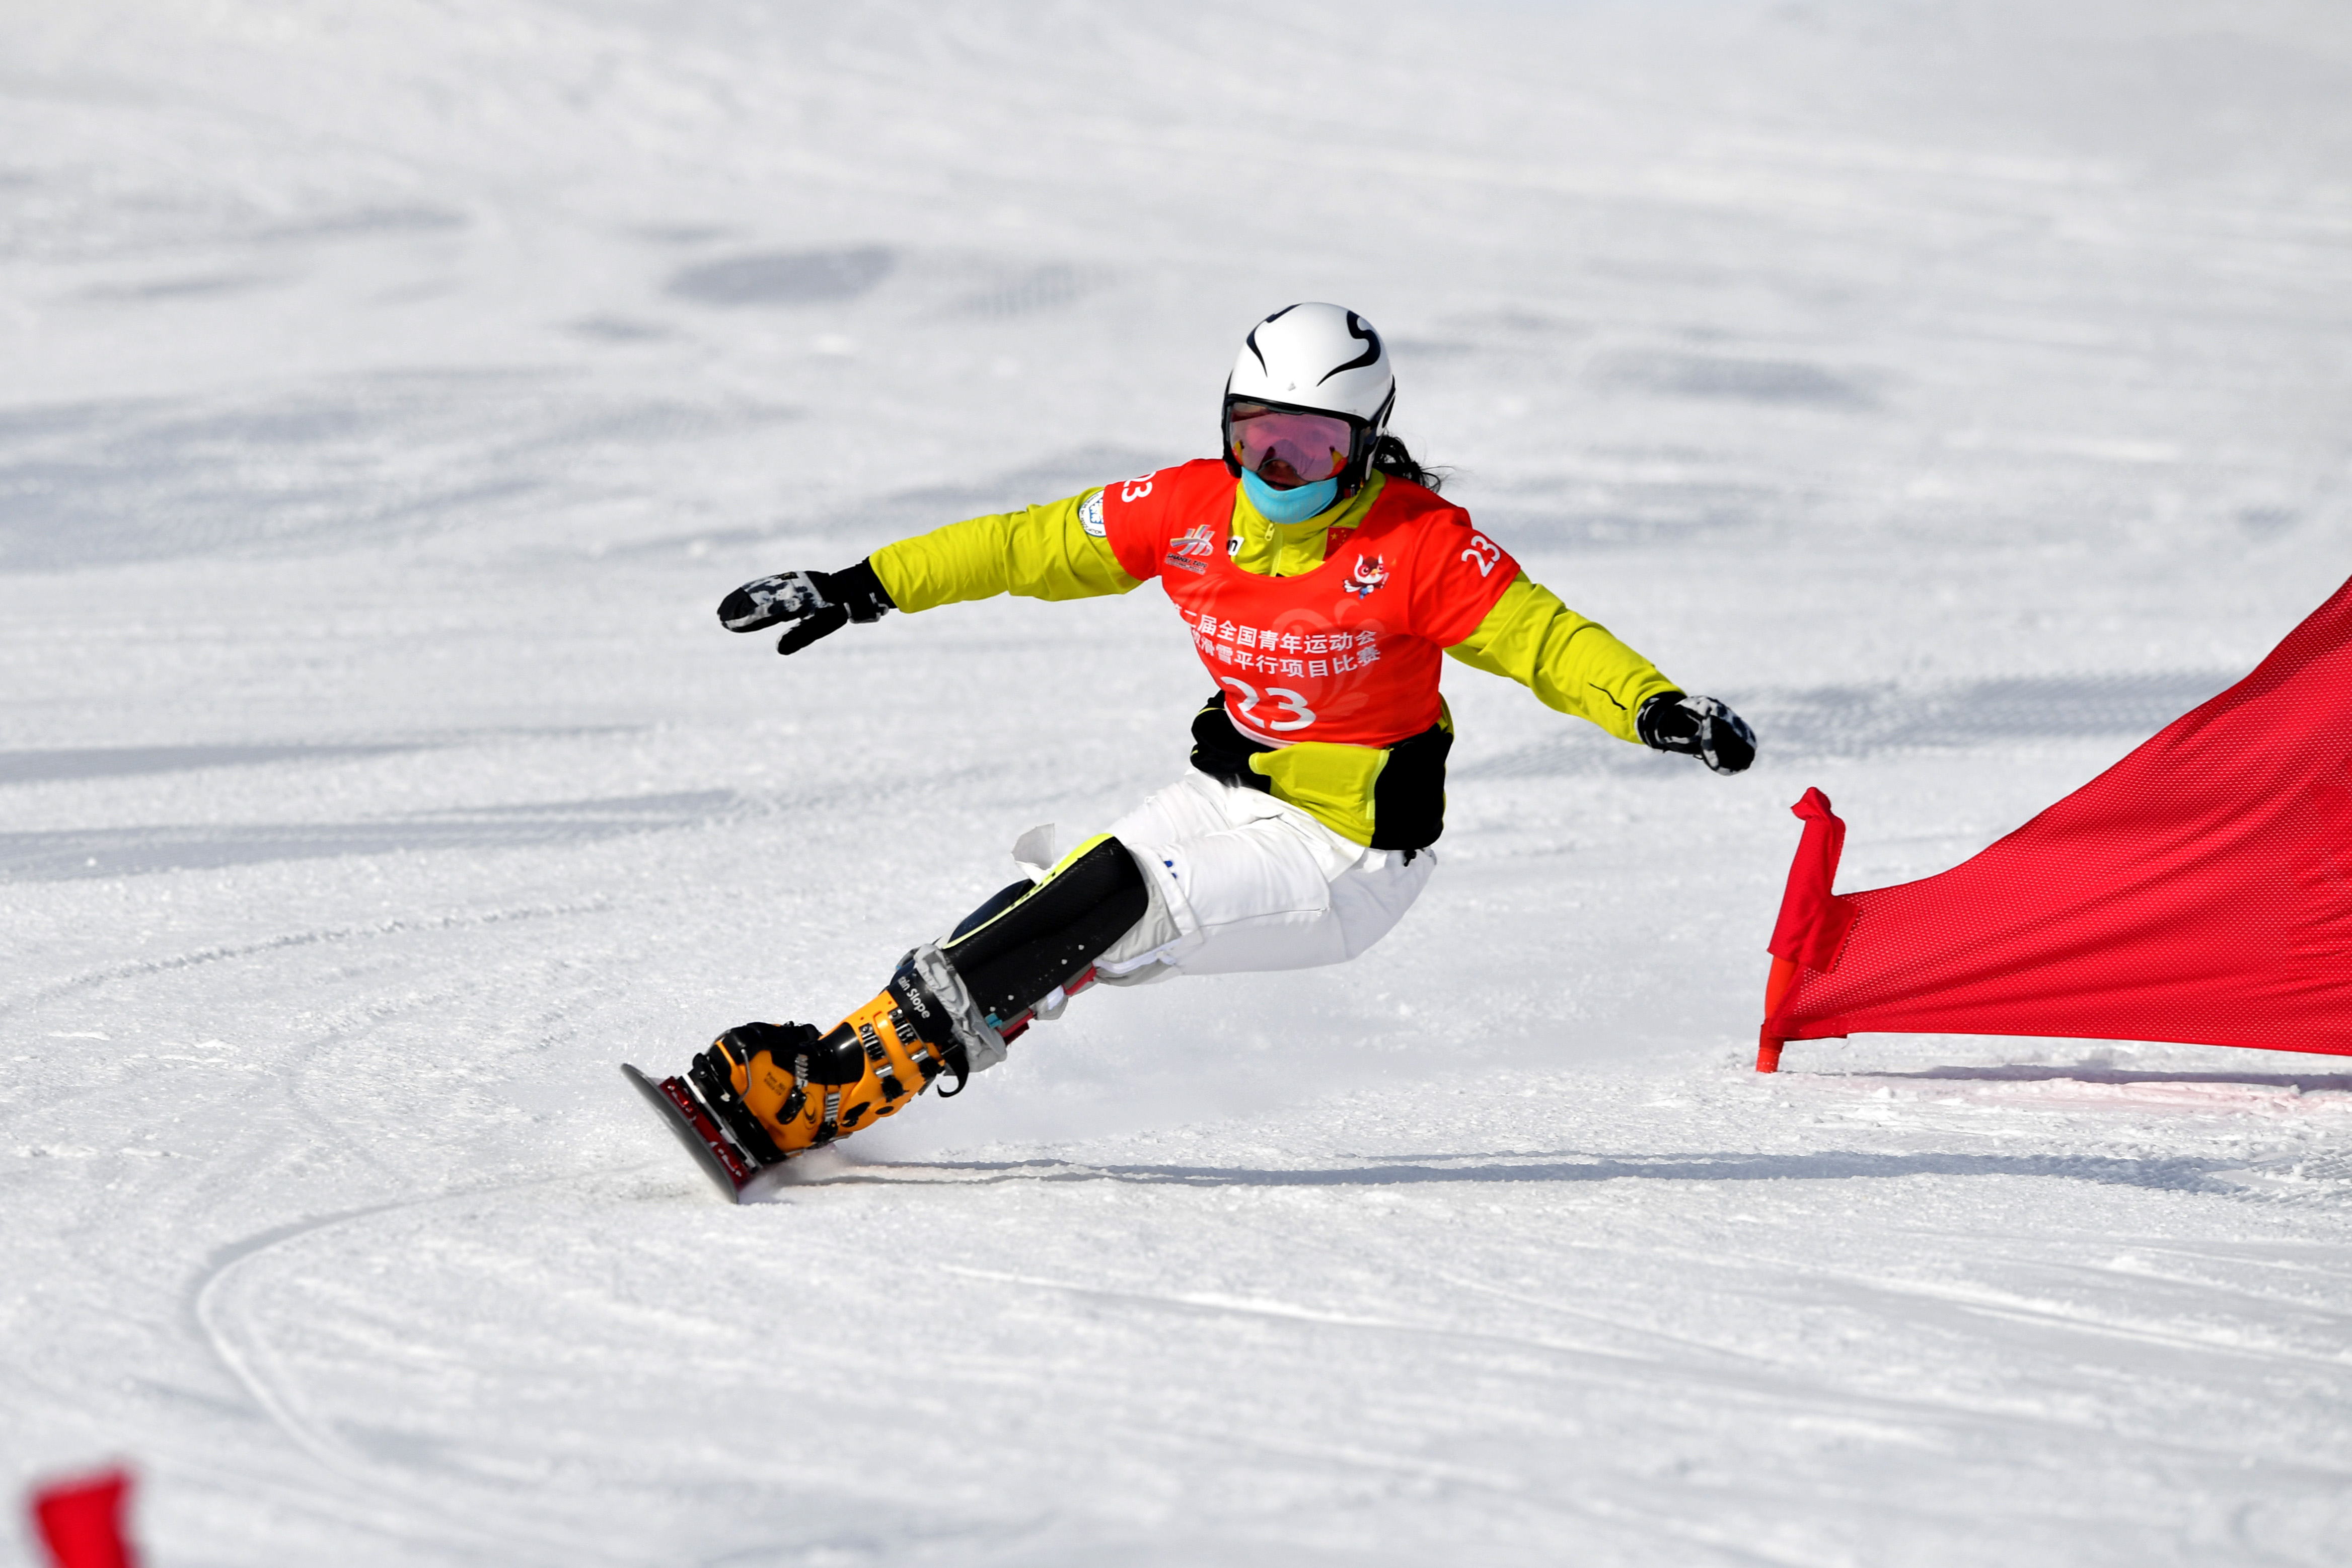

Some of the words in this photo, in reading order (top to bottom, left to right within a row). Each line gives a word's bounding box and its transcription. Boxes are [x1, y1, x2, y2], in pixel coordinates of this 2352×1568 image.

[1461, 535, 1500, 577] 23
[1220, 676, 1316, 731] 23
[907, 988, 930, 1019] Slope
